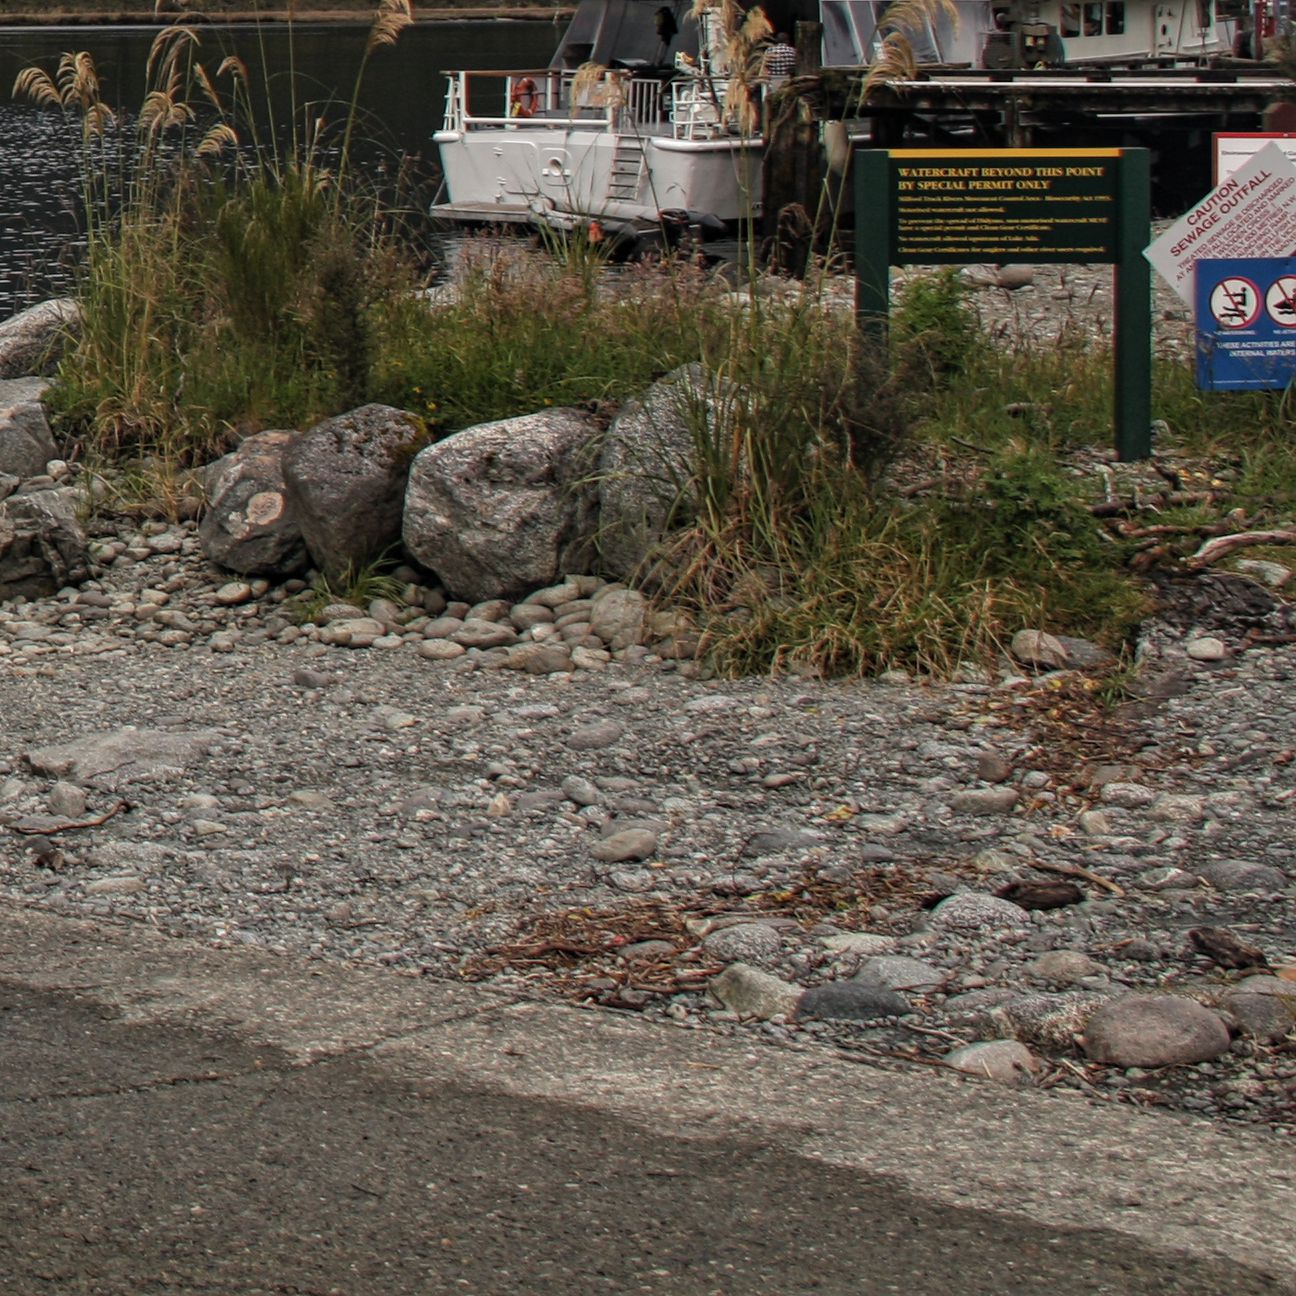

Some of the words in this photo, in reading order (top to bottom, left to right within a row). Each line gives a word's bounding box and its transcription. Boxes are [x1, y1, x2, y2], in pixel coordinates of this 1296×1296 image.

[898, 168, 979, 177] WATERCRAFT
[981, 168, 1032, 177] BEYOND
[1036, 168, 1063, 177] THIS
[1066, 168, 1104, 177] POINT
[898, 180, 914, 190] BY
[917, 180, 966, 190] SPECIAL
[968, 180, 1014, 190] PERMIT
[1016, 180, 1050, 190] ONLY
[1170, 211, 1221, 257] SEWAGE
[1219, 169, 1273, 215] OUTFALL
[1186, 178, 1239, 226] CAUTION
